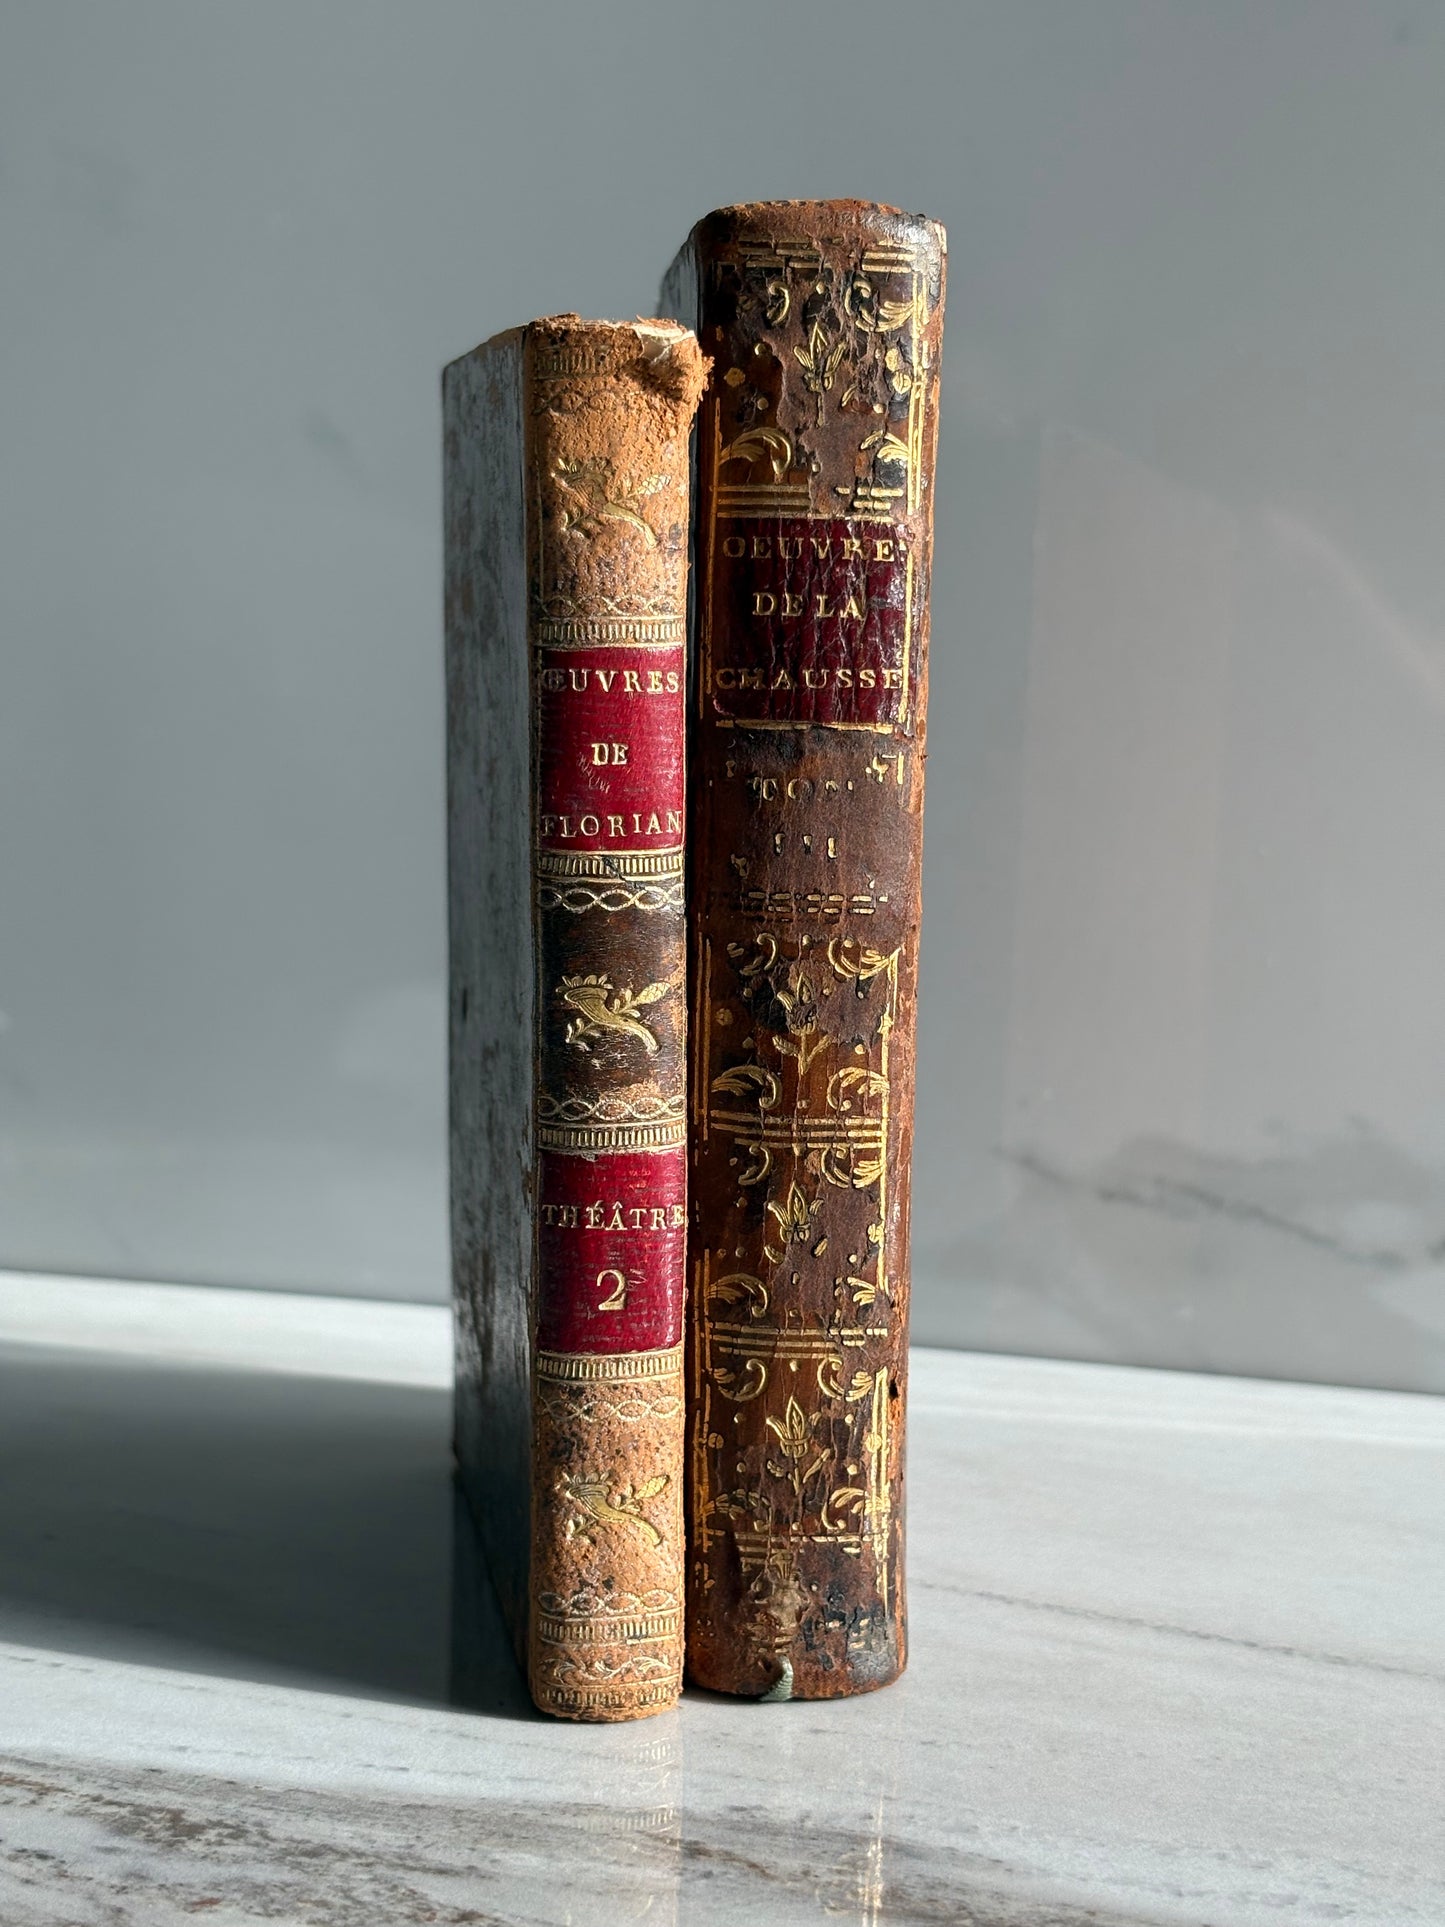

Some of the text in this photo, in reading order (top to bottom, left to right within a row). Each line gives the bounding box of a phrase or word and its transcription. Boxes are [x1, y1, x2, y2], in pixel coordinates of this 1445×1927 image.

[752, 592, 866, 620] DE LA
[591, 742, 629, 766] DE
[542, 810, 683, 838] FLORIAN
[541, 1199, 685, 1231] THÉÂTRE
[596, 1268, 627, 1311] 2
